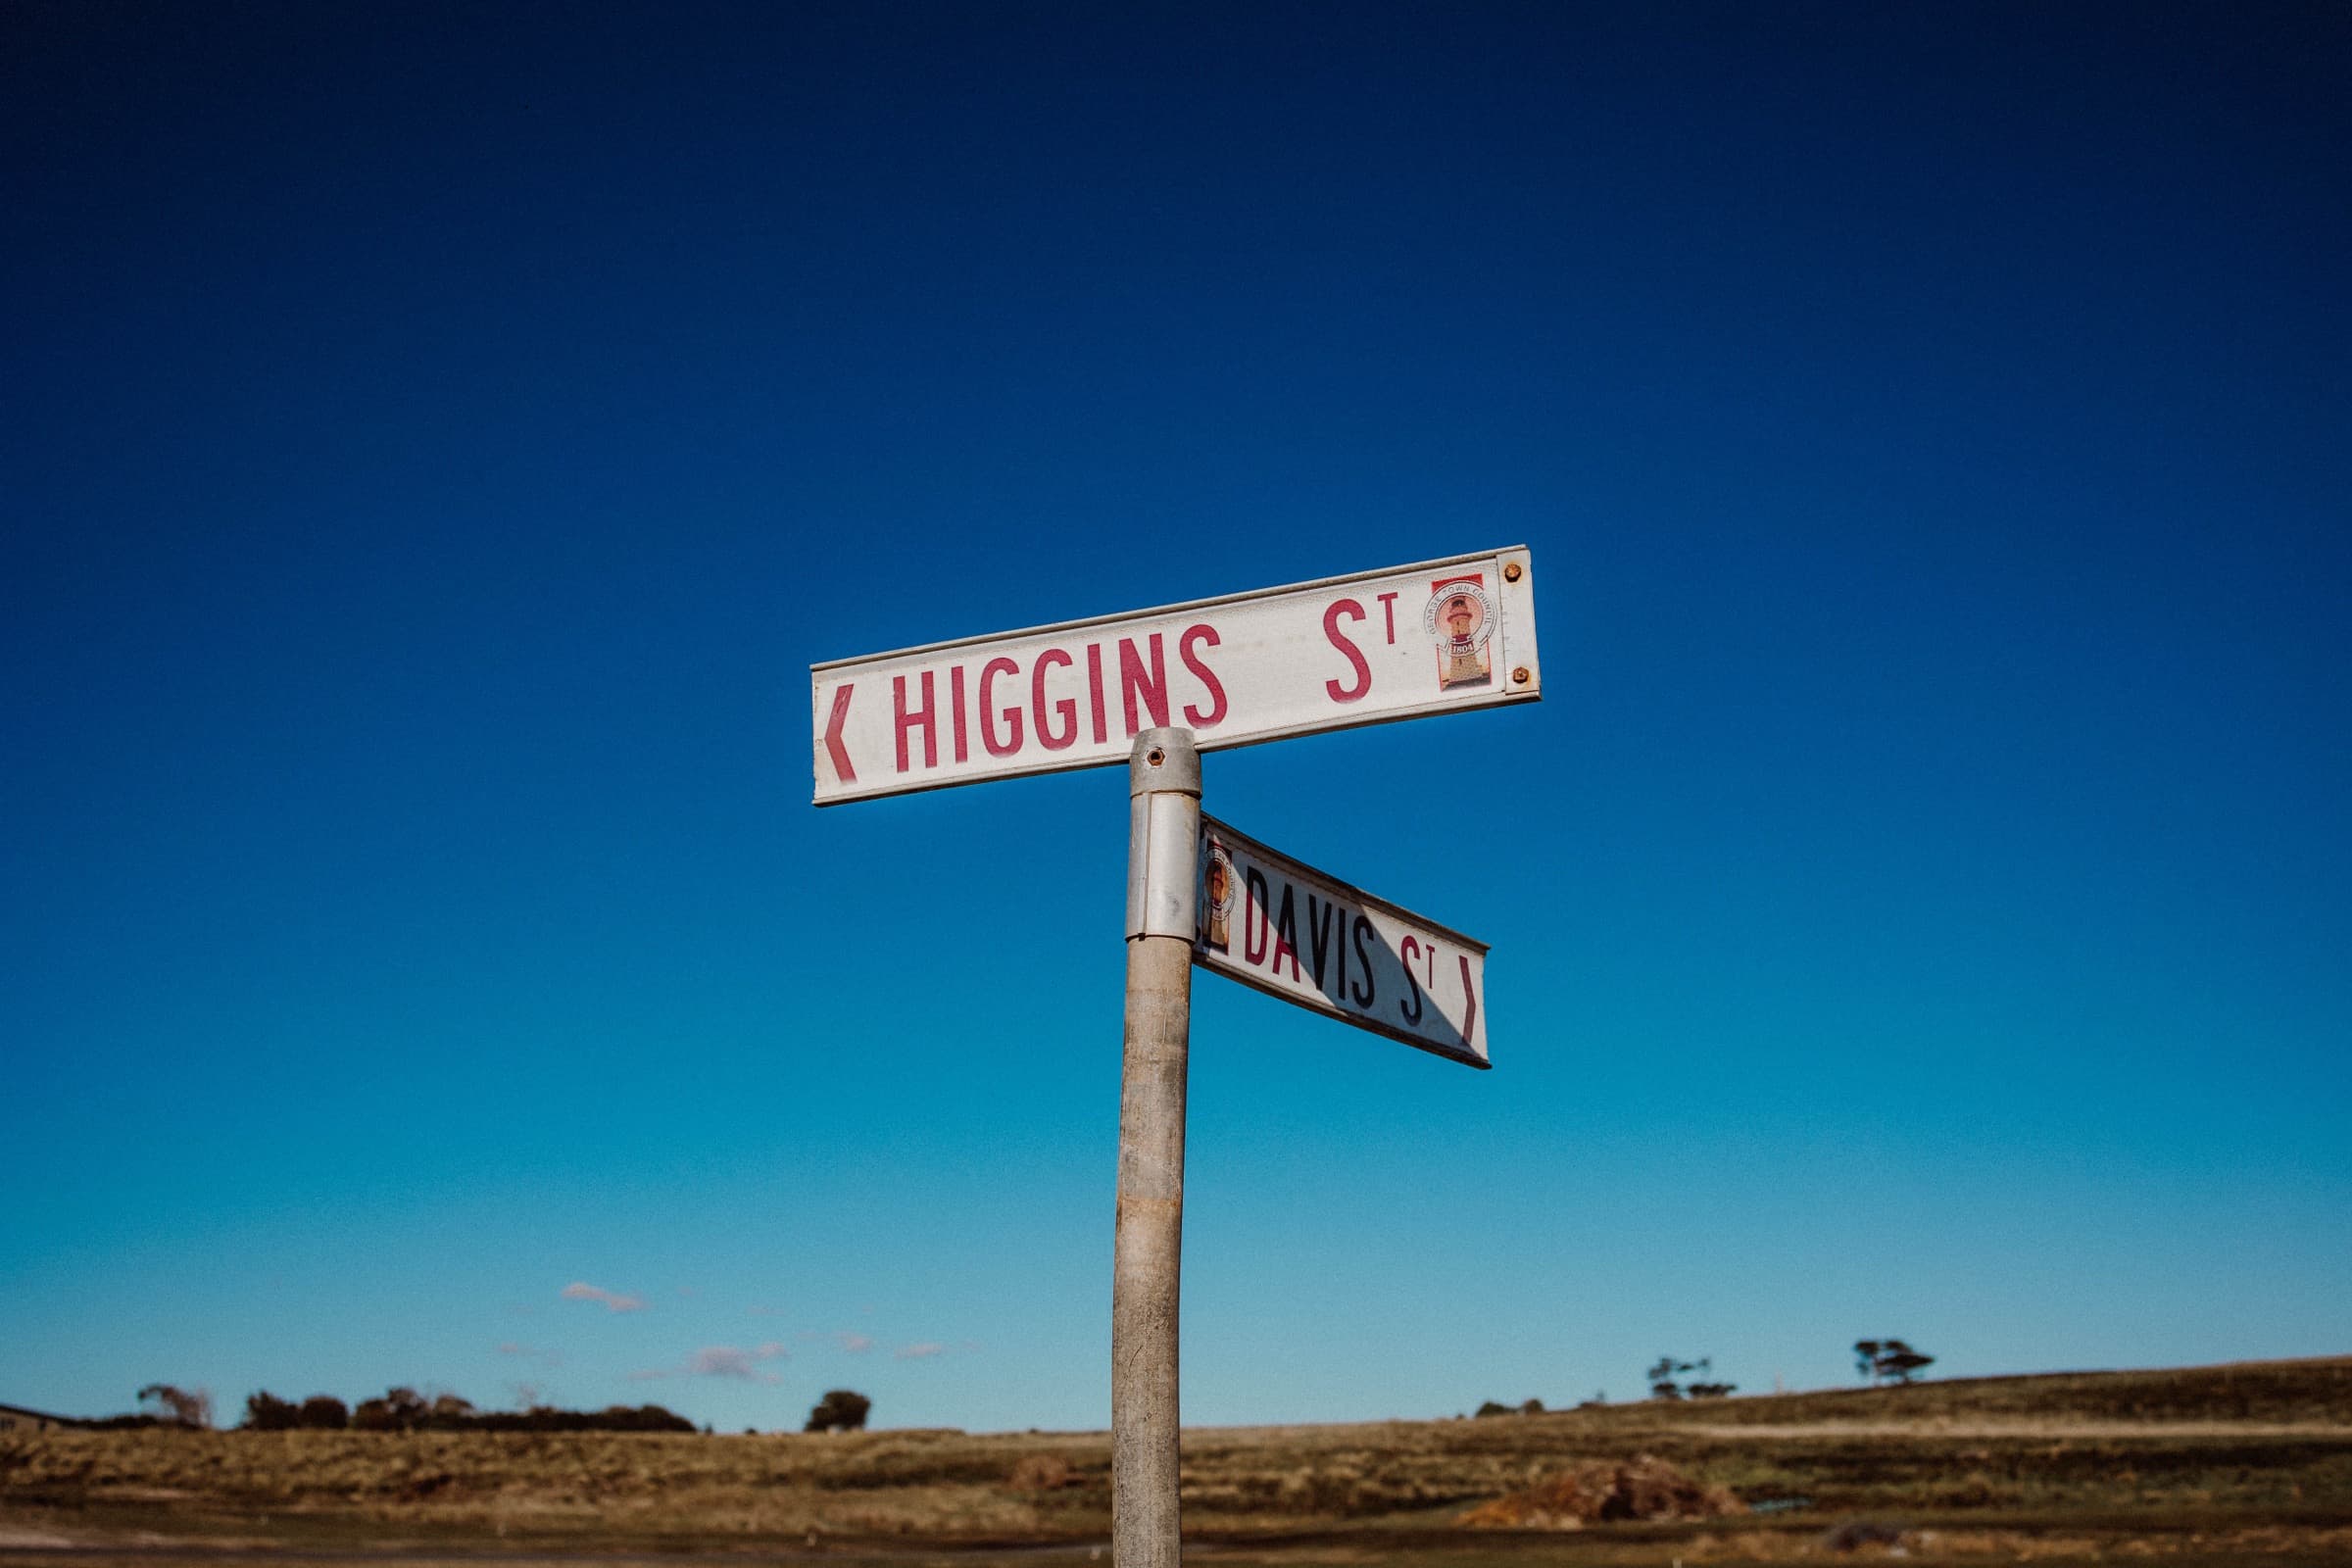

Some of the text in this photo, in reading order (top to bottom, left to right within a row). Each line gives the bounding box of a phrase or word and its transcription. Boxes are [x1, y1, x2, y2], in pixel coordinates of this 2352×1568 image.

[1442, 585, 1471, 597] TOWN
[893, 592, 1398, 772] HIGGINS ST
[1245, 866, 1374, 1009] DAVIS
[1400, 935, 1436, 1027] ST
